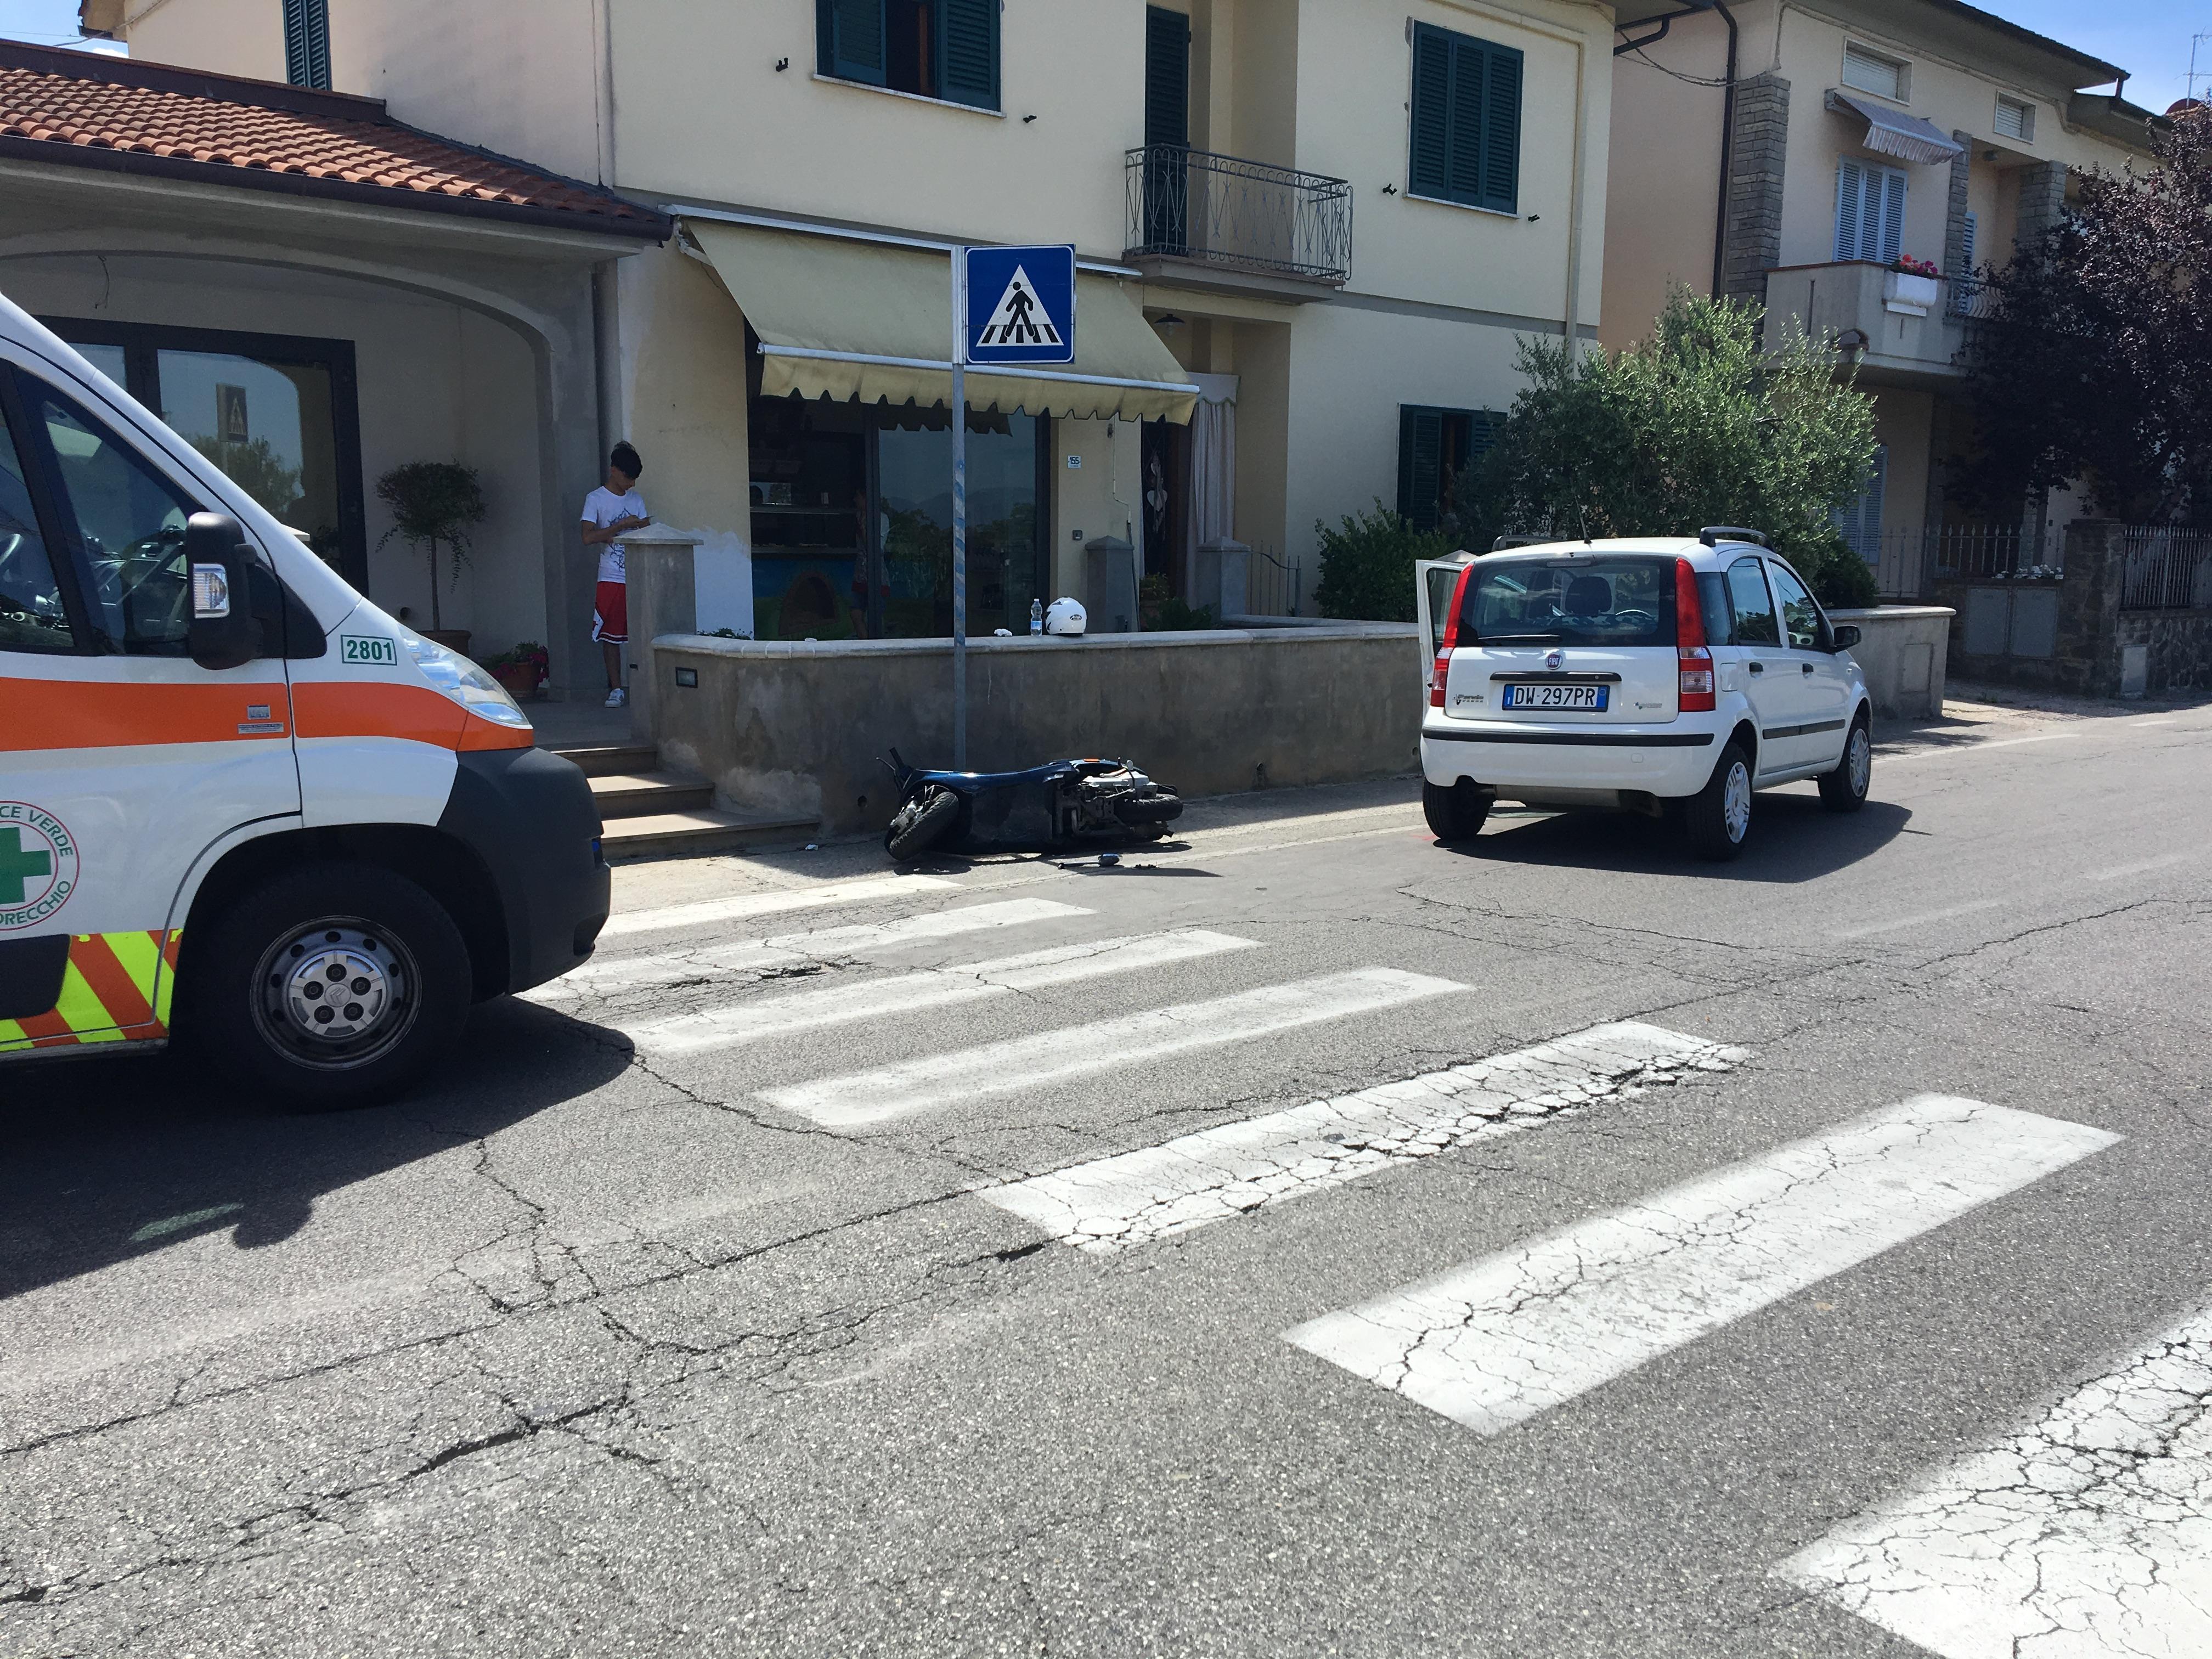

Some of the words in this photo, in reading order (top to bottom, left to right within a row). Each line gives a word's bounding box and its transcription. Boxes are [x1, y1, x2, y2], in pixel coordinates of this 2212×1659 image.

[1070, 456, 1079, 465] 155
[347, 640, 392, 661] 2801
[1549, 657, 1559, 665] FIAT
[1541, 687, 1595, 706] 297PR
[29, 809, 74, 857] VERDE
